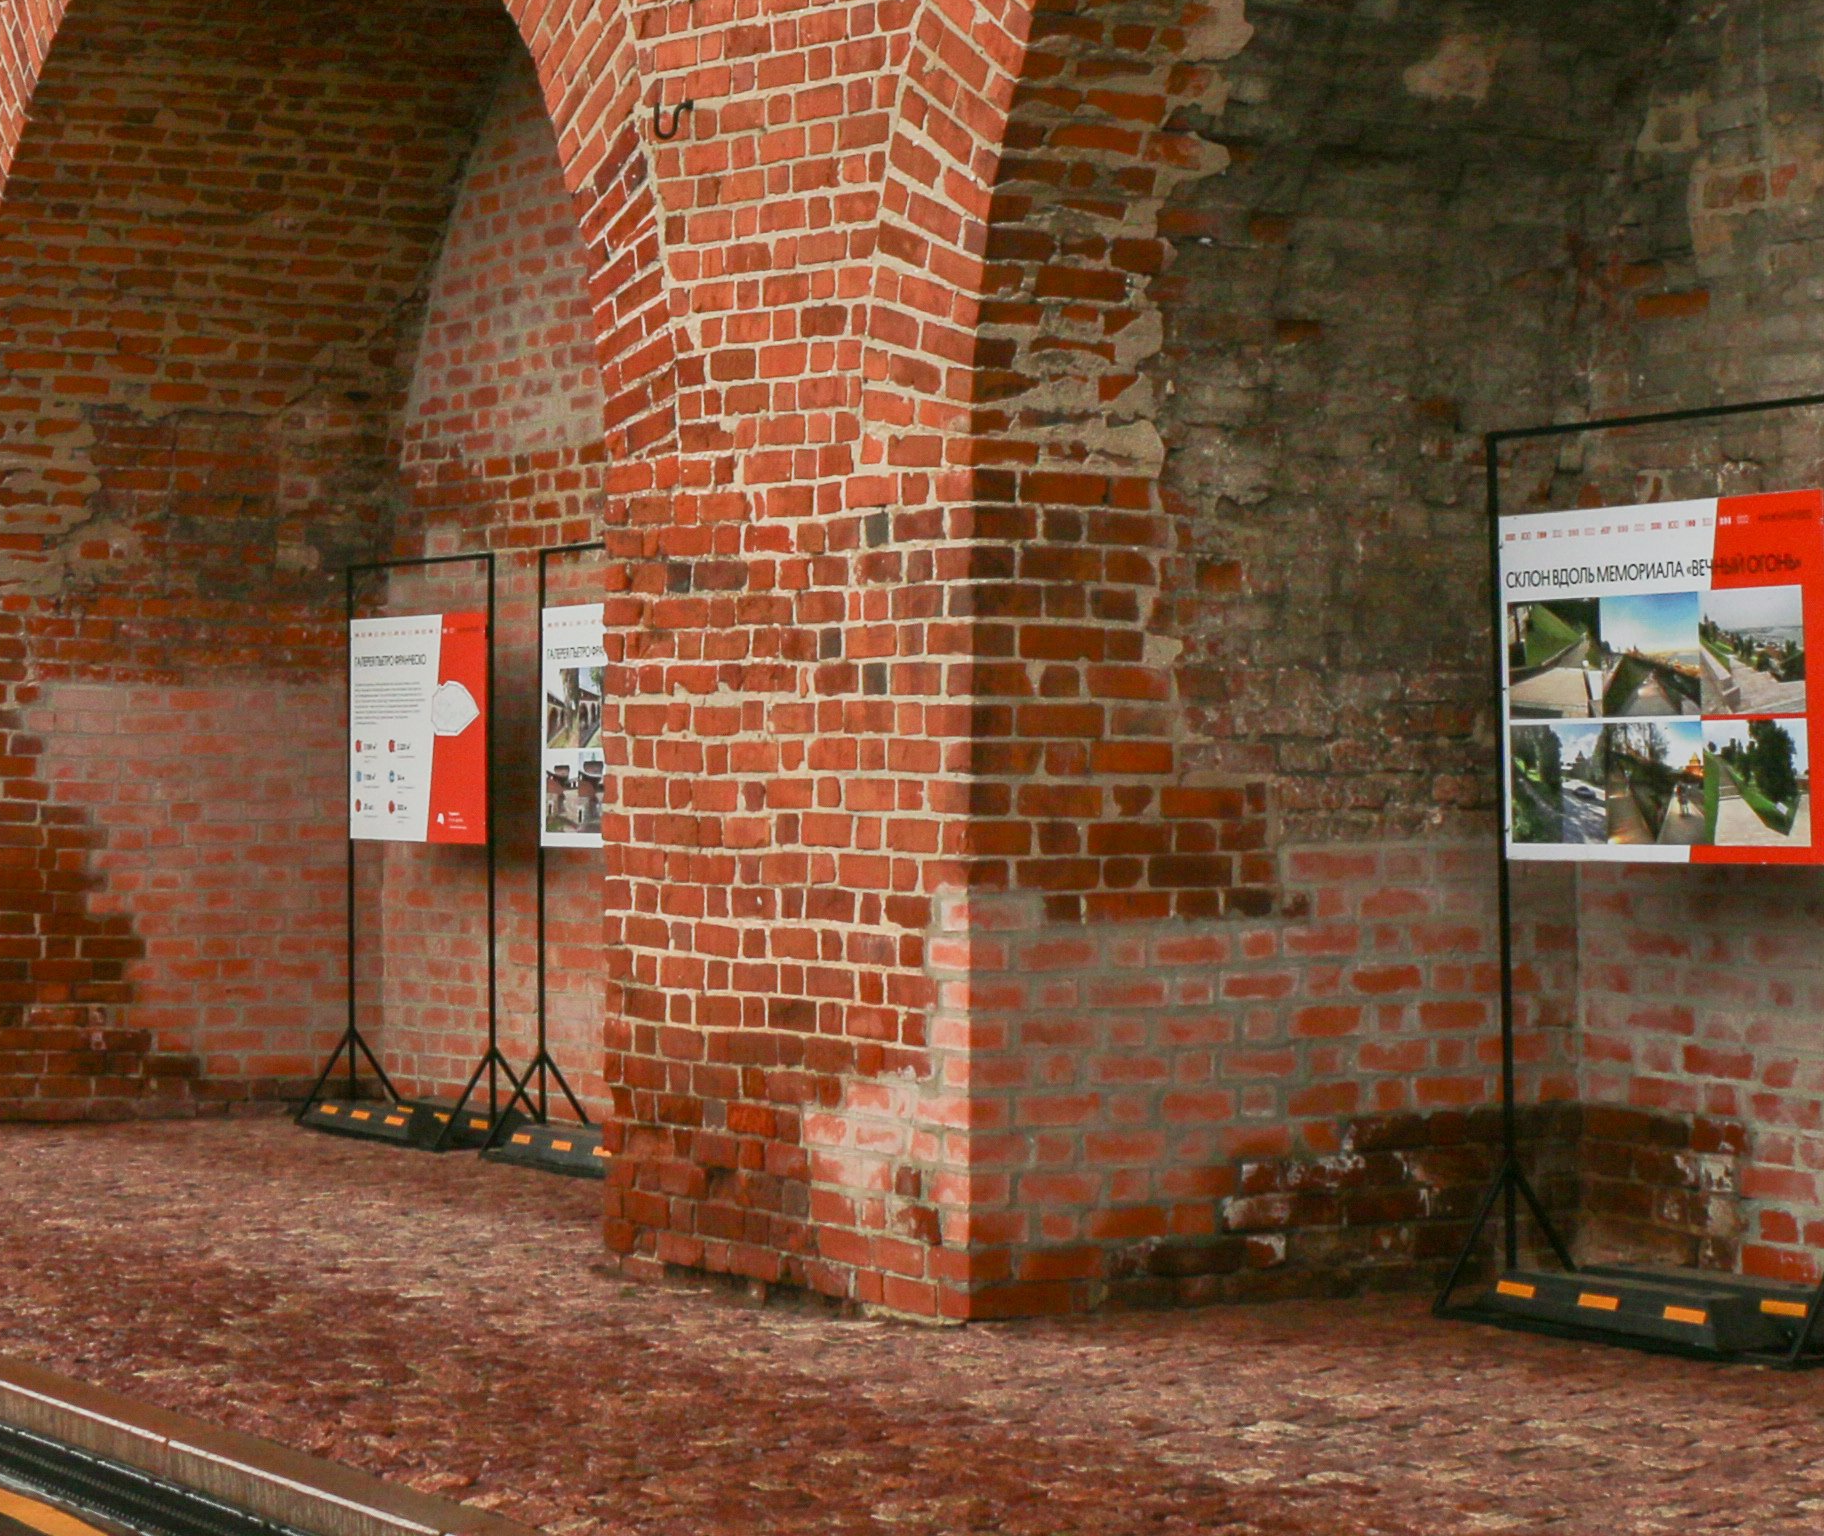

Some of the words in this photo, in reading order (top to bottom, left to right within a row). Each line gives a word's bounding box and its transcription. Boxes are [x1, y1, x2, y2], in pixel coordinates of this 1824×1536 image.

[1506, 569, 1551, 589] СКЛОН
[1553, 567, 1595, 588] ВДОЛЬ
[1597, 560, 1684, 583] МЕМОРИАЛА
